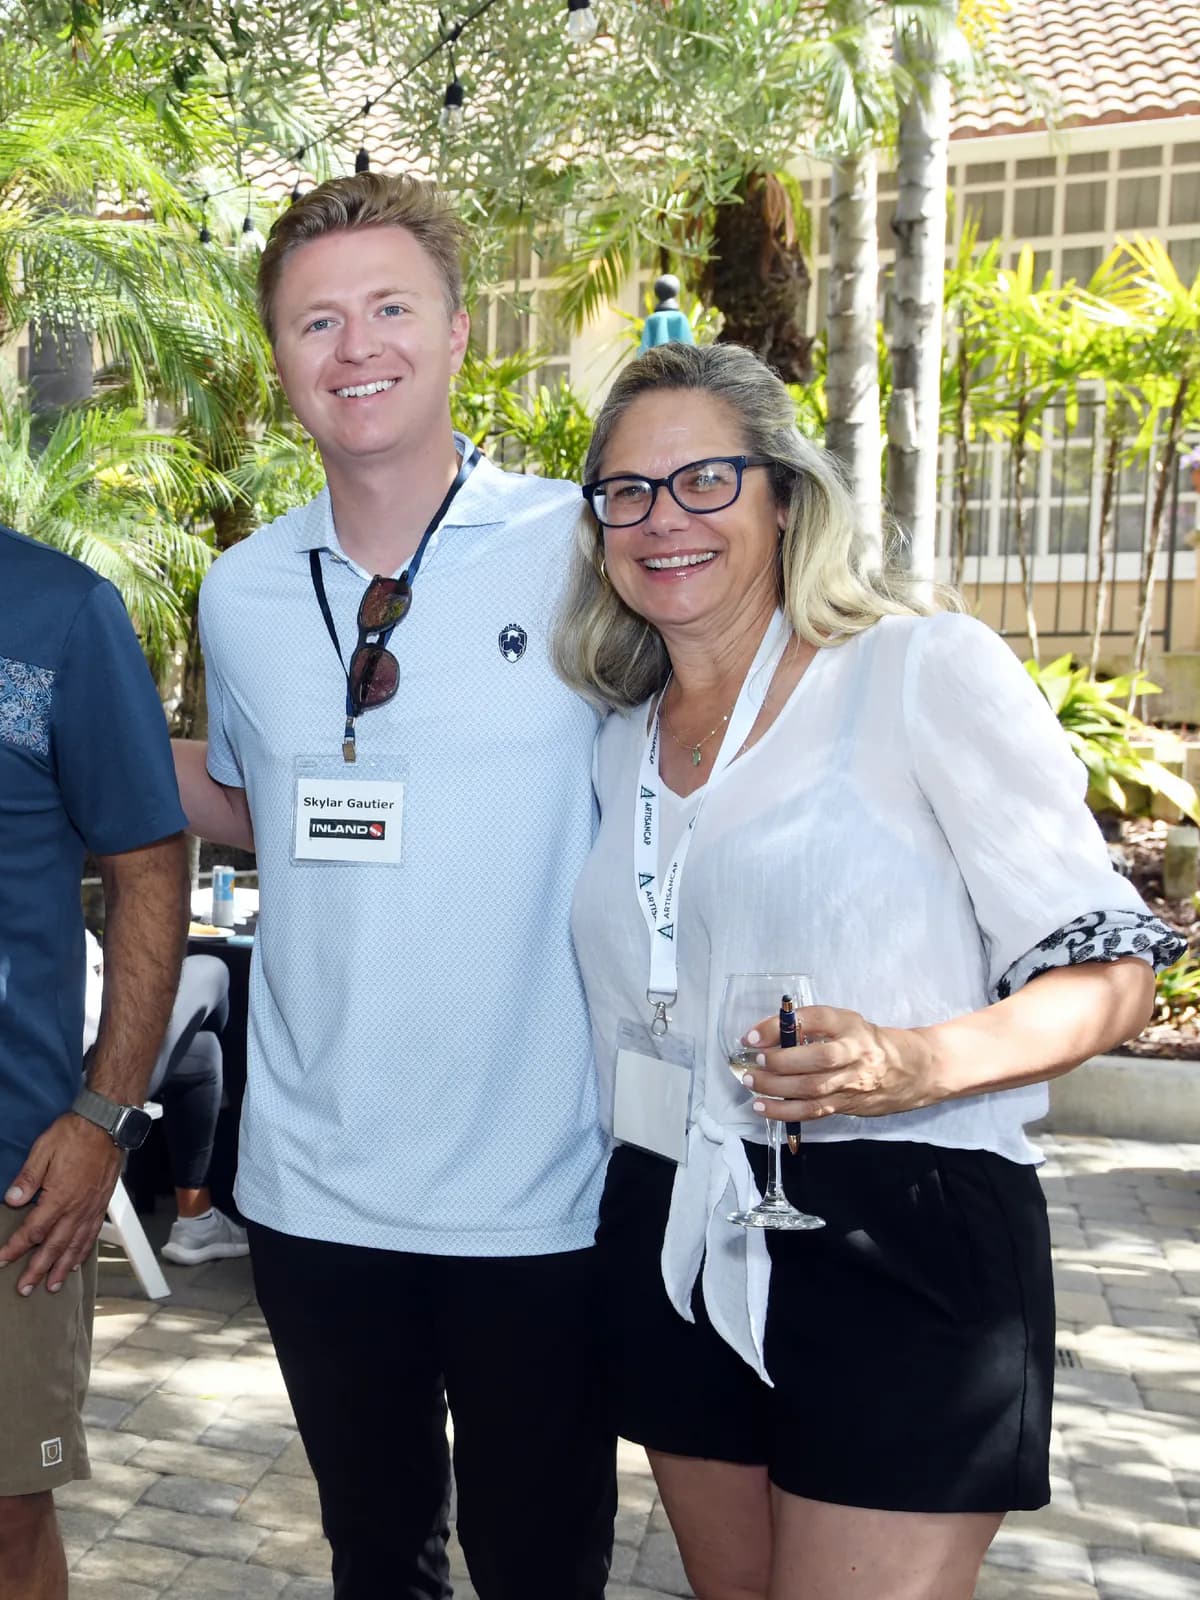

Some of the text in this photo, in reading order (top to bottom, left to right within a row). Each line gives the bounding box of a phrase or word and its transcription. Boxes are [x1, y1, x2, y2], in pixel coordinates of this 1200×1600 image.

[303, 796, 395, 809] Skylar Gautier
[312, 823, 368, 834] INLAND
[643, 801, 653, 846] ARTISANCAP
[663, 862, 678, 919] ARTISANCAP
